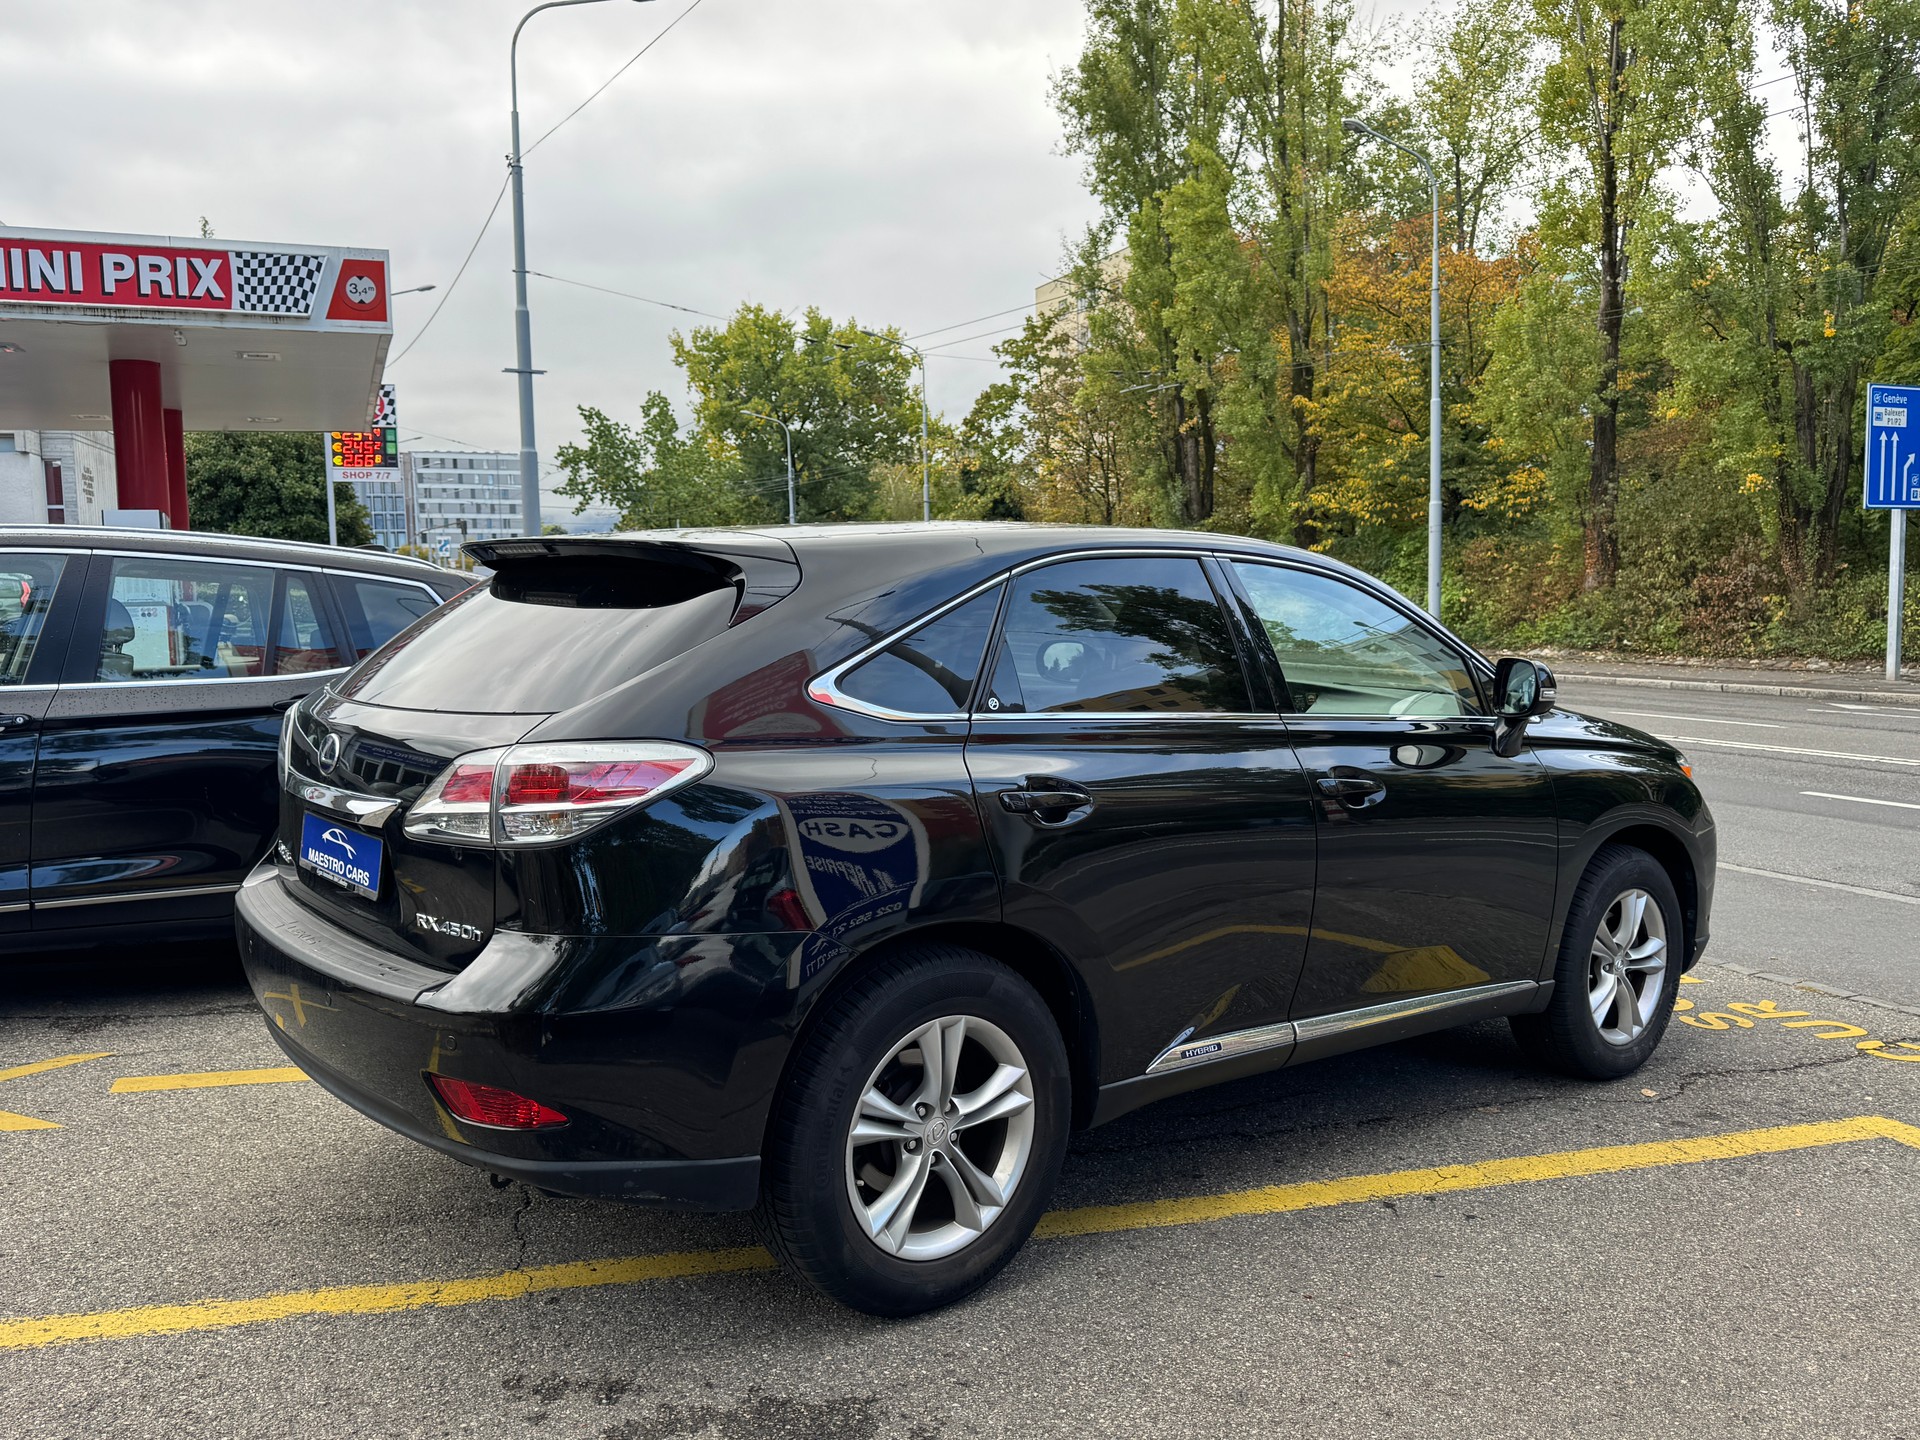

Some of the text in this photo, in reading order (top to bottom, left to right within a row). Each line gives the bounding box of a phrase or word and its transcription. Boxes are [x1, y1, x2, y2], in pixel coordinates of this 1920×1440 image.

[0, 247, 226, 299] INI PRIX
[1883, 393, 1908, 404] Genève
[1884, 408, 1906, 417] Balexert
[342, 471, 391, 480] SHOP 7/7
[307, 847, 345, 876] MAESTRO
[345, 864, 370, 887] CARS
[1185, 1043, 1219, 1058] HYBRID
